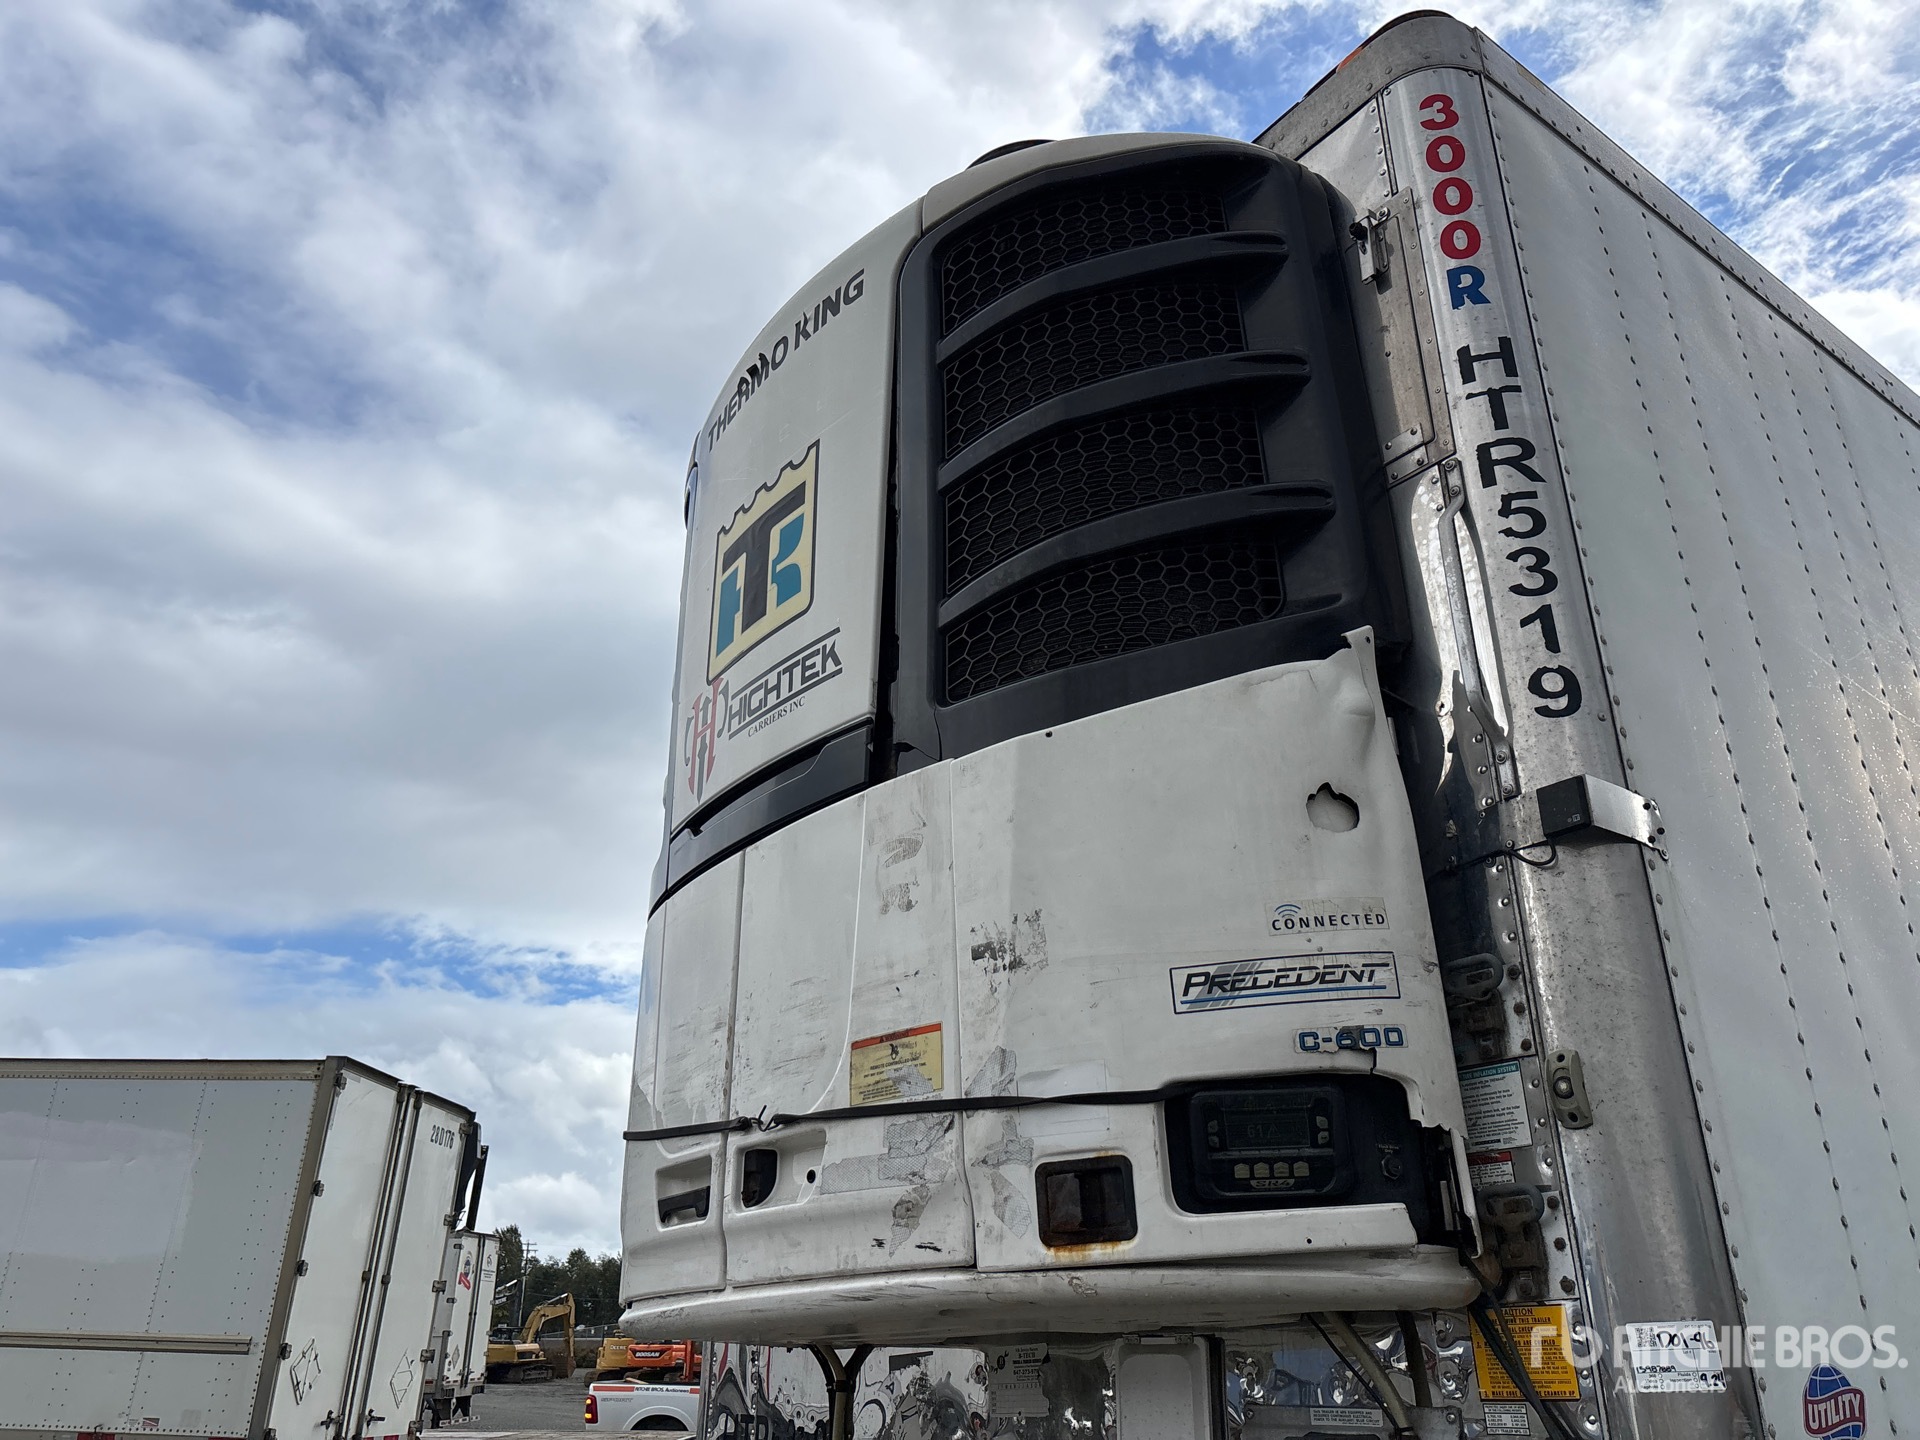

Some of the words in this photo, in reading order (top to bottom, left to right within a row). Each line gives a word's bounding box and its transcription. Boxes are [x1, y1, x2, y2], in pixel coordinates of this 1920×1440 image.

[707, 335, 790, 453] THERMO
[793, 268, 866, 352] KING
[1418, 93, 1491, 311] 3000R
[1456, 336, 1583, 719] HTR5319
[727, 638, 842, 734] HIGHTEK
[747, 706, 788, 738] CARRIERS
[789, 695, 806, 713] INC
[1271, 913, 1385, 931] CONNECTED
[1182, 962, 1390, 997] PRECEDENT
[1298, 1026, 1404, 1052] C-600
[1807, 1393, 1861, 1430] UTILITY
